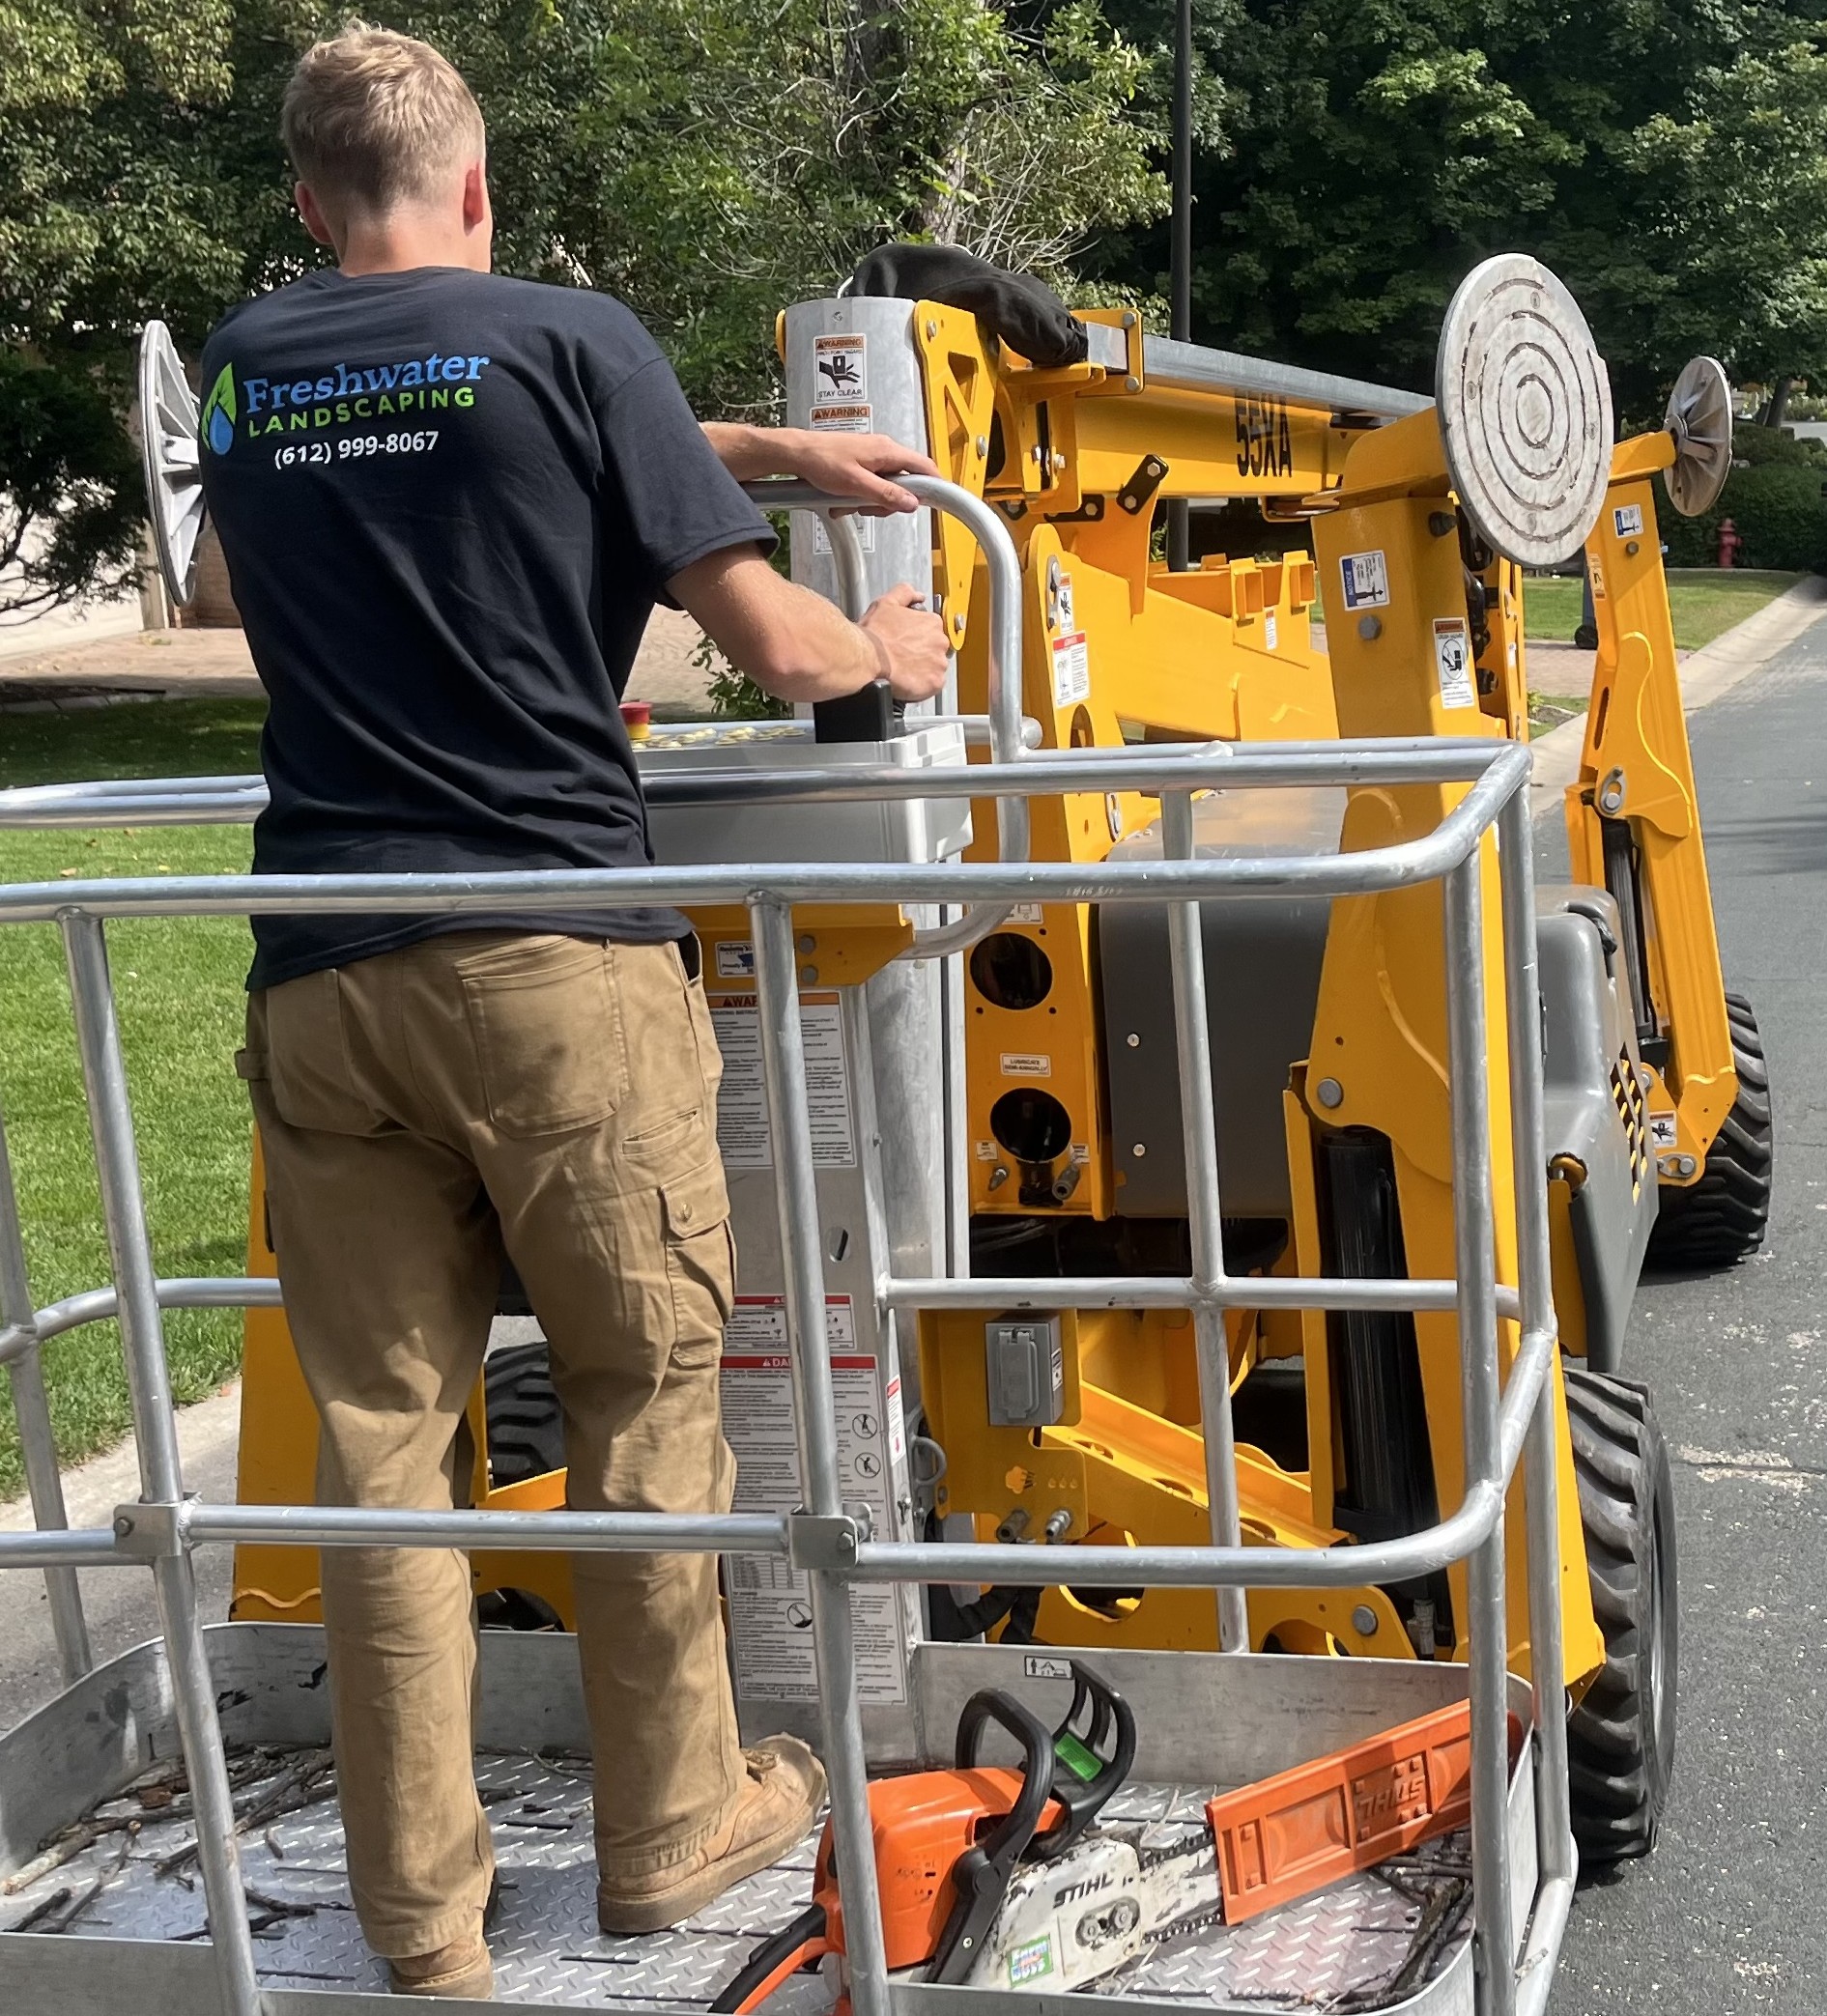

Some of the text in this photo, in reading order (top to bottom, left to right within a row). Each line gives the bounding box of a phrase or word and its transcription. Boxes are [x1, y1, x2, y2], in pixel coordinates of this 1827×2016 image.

[823, 338, 862, 348] WARNING
[243, 353, 490, 413] Freshwater
[817, 388, 863, 399] STAY CLEAR
[248, 386, 476, 439] LANDSCAPING
[822, 407, 868, 418] WARNING
[274, 431, 439, 470] (612) 999-8067
[1234, 390, 1293, 478] 55XA
[1358, 1775, 1426, 1819] STIHL
[1052, 1872, 1114, 1910] STIHL
